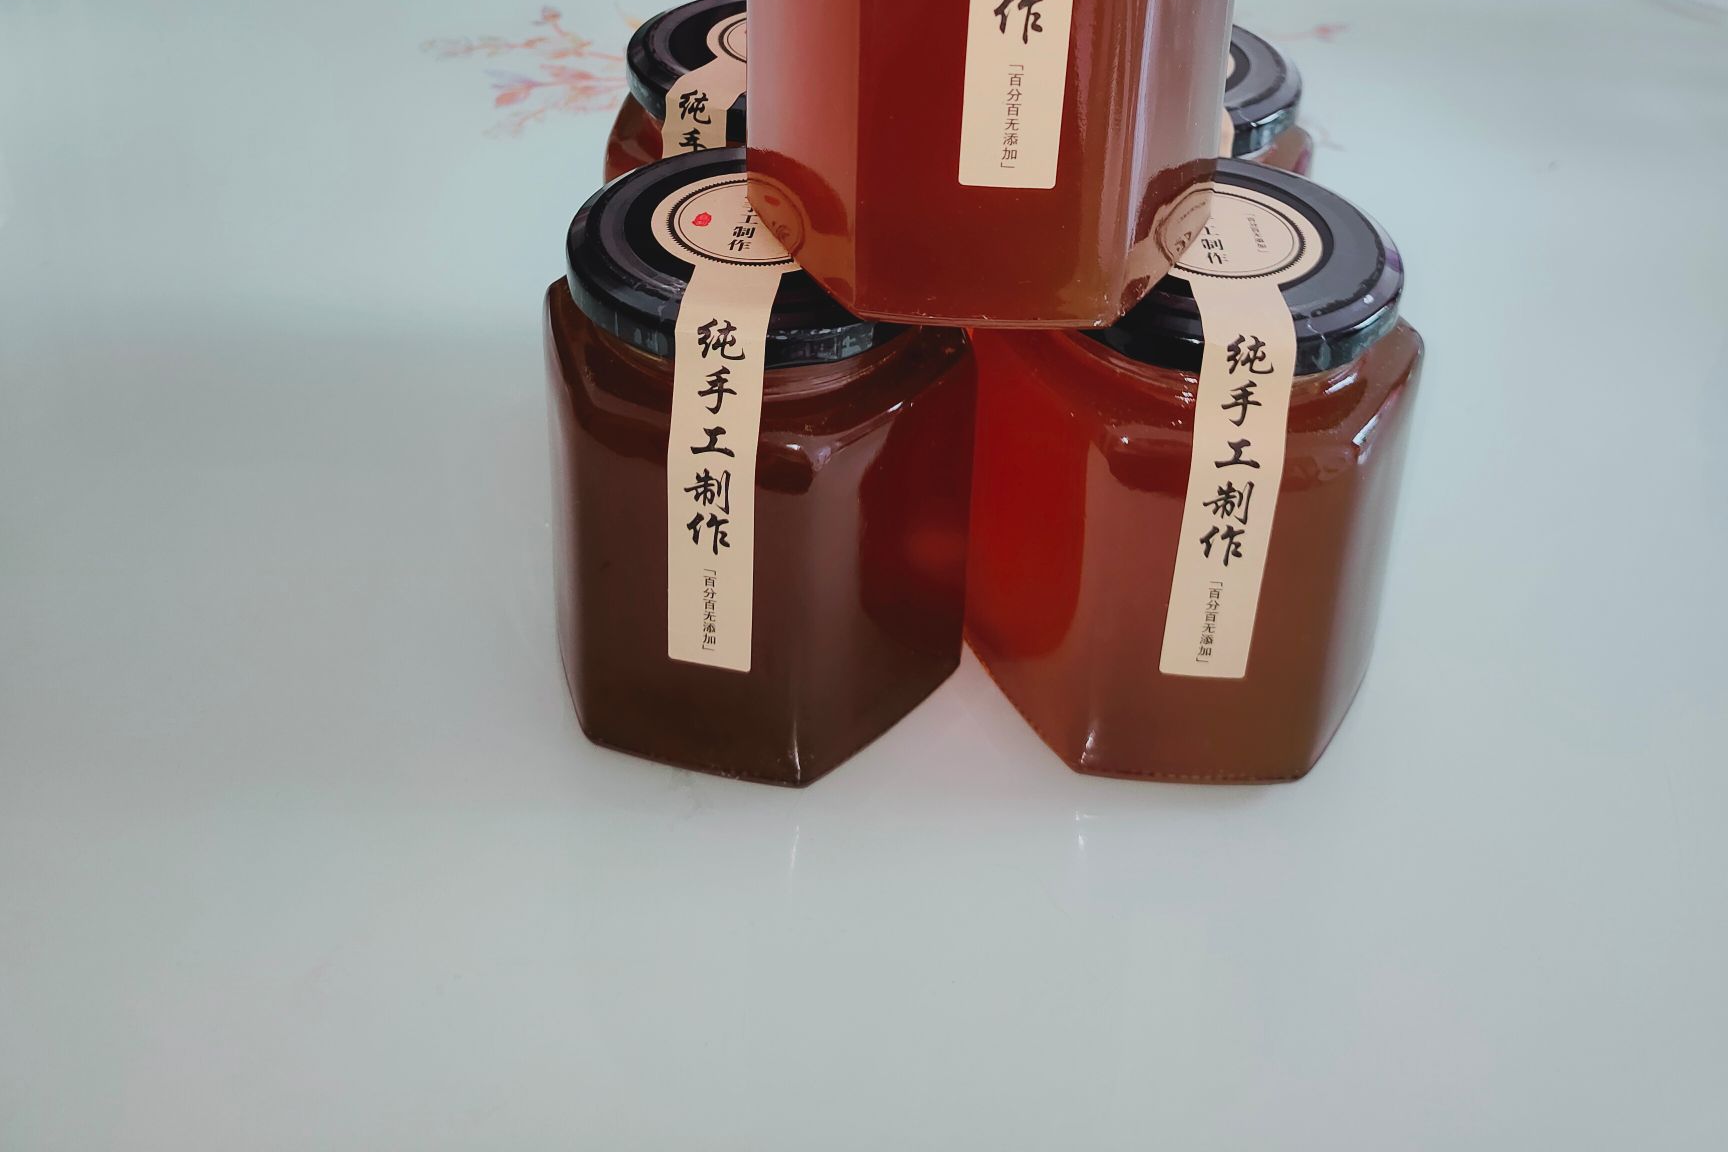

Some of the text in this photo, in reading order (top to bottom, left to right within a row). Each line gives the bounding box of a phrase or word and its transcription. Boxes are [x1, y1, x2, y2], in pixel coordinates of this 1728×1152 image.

[1000, 63, 1025, 168] 「百分百无添加」
[684, 318, 745, 555] 纯手工制作
[1200, 334, 1274, 567] 纯手工制作
